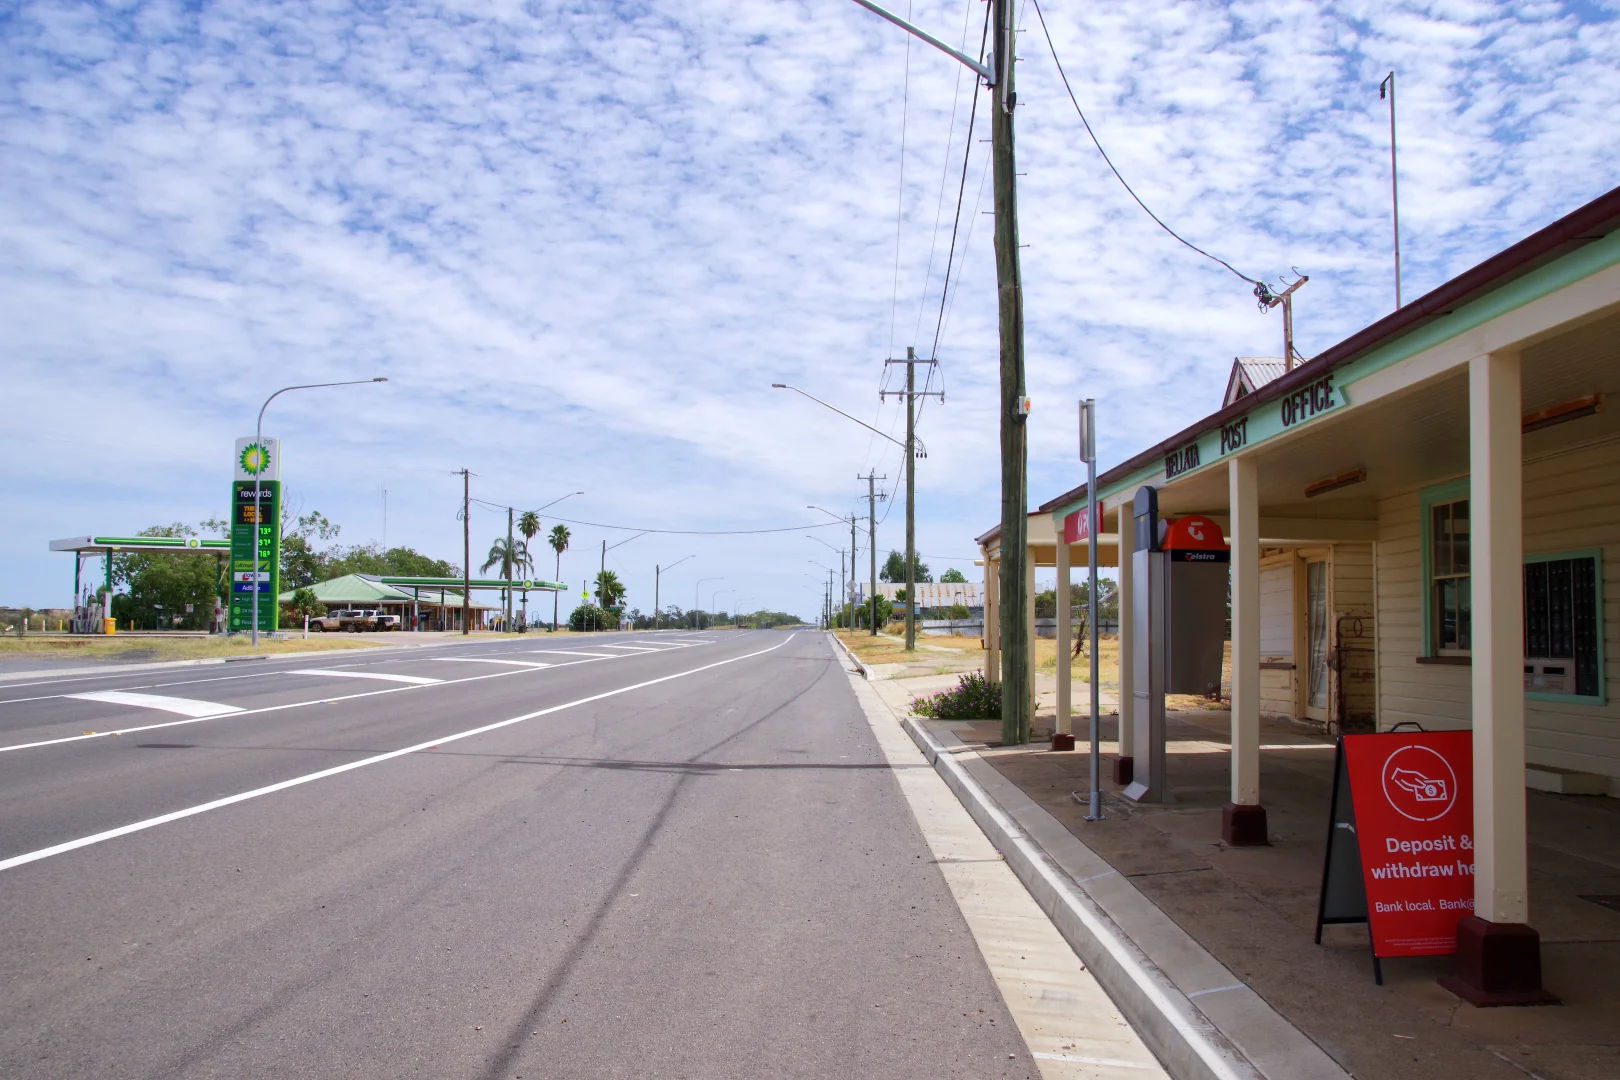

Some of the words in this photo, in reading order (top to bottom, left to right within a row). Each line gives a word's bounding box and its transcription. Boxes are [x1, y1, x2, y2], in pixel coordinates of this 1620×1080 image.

[1164, 443, 1200, 479] BELLATA
[1220, 417, 1248, 455] POST
[1281, 374, 1334, 426] OFFICE
[240, 489, 272, 498] rewrds
[1186, 552, 1215, 562] Telstra
[1386, 834, 1456, 855] Deposit
[1460, 834, 1474, 850] &
[1370, 861, 1454, 879] withdraw
[1375, 900, 1404, 913] Bank
[1405, 900, 1435, 911] local.
